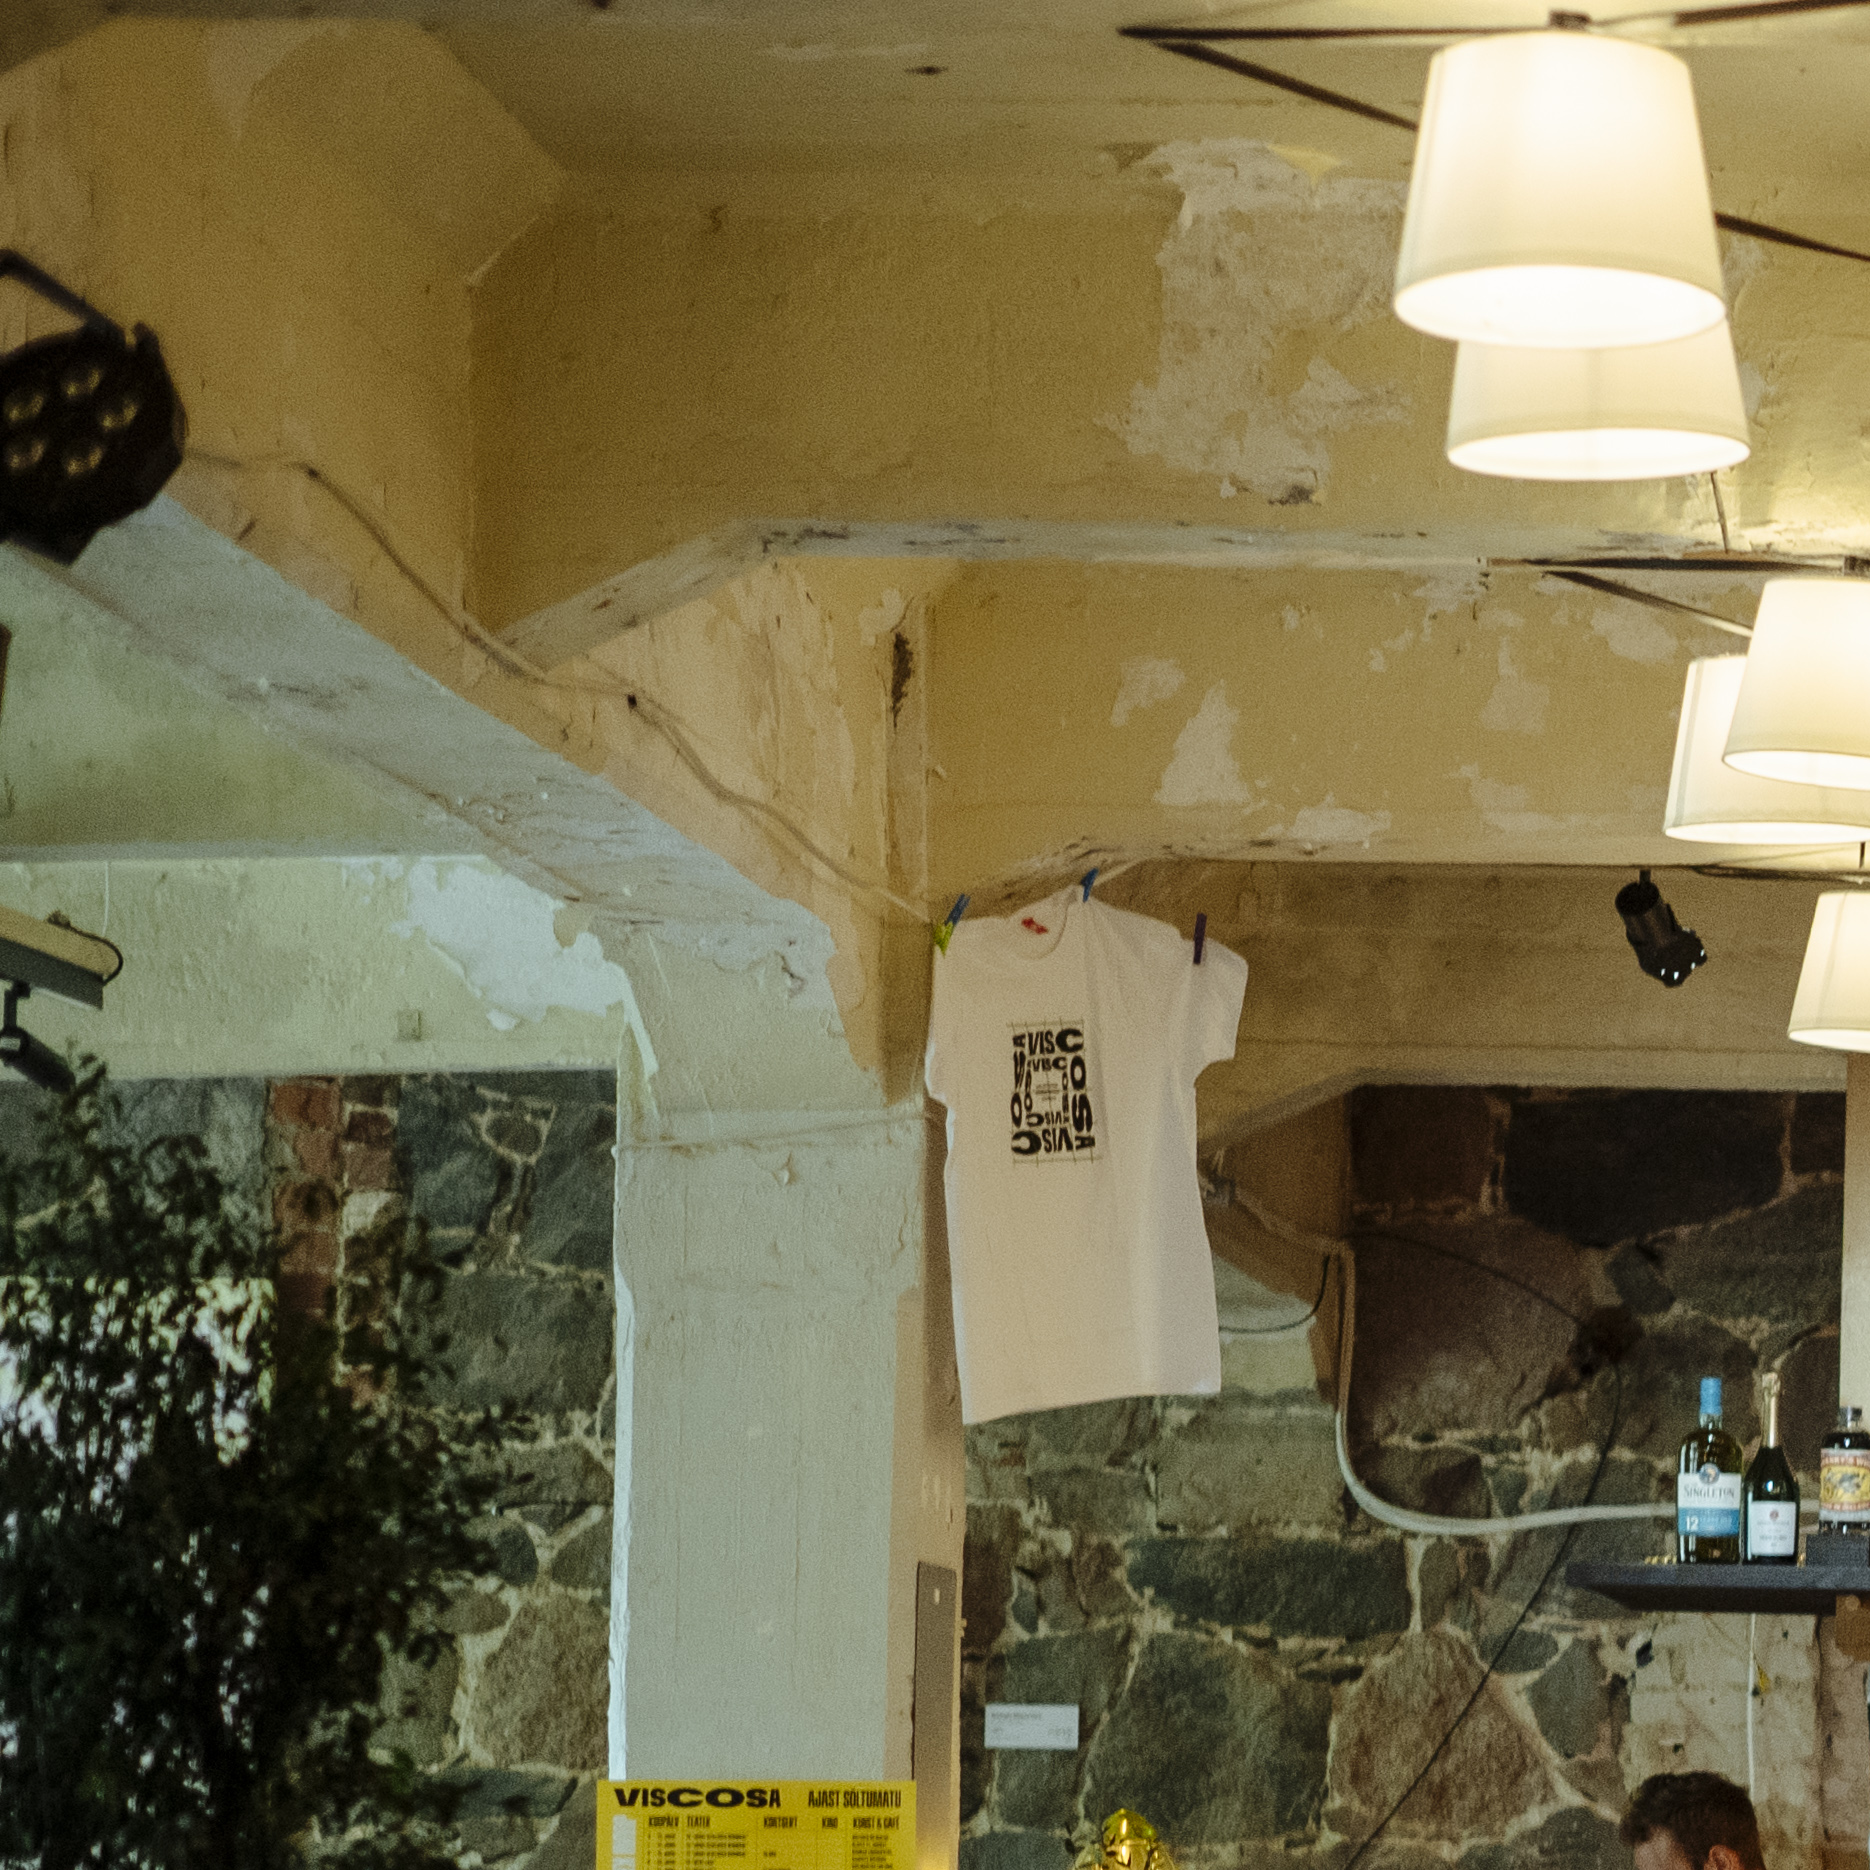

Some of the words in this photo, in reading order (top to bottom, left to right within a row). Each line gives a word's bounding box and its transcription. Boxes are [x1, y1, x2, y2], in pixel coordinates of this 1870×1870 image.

[1685, 1515, 1699, 1532] 12
[614, 1787, 781, 1808] VISCOSA
[808, 1789, 840, 1808] AJAST
